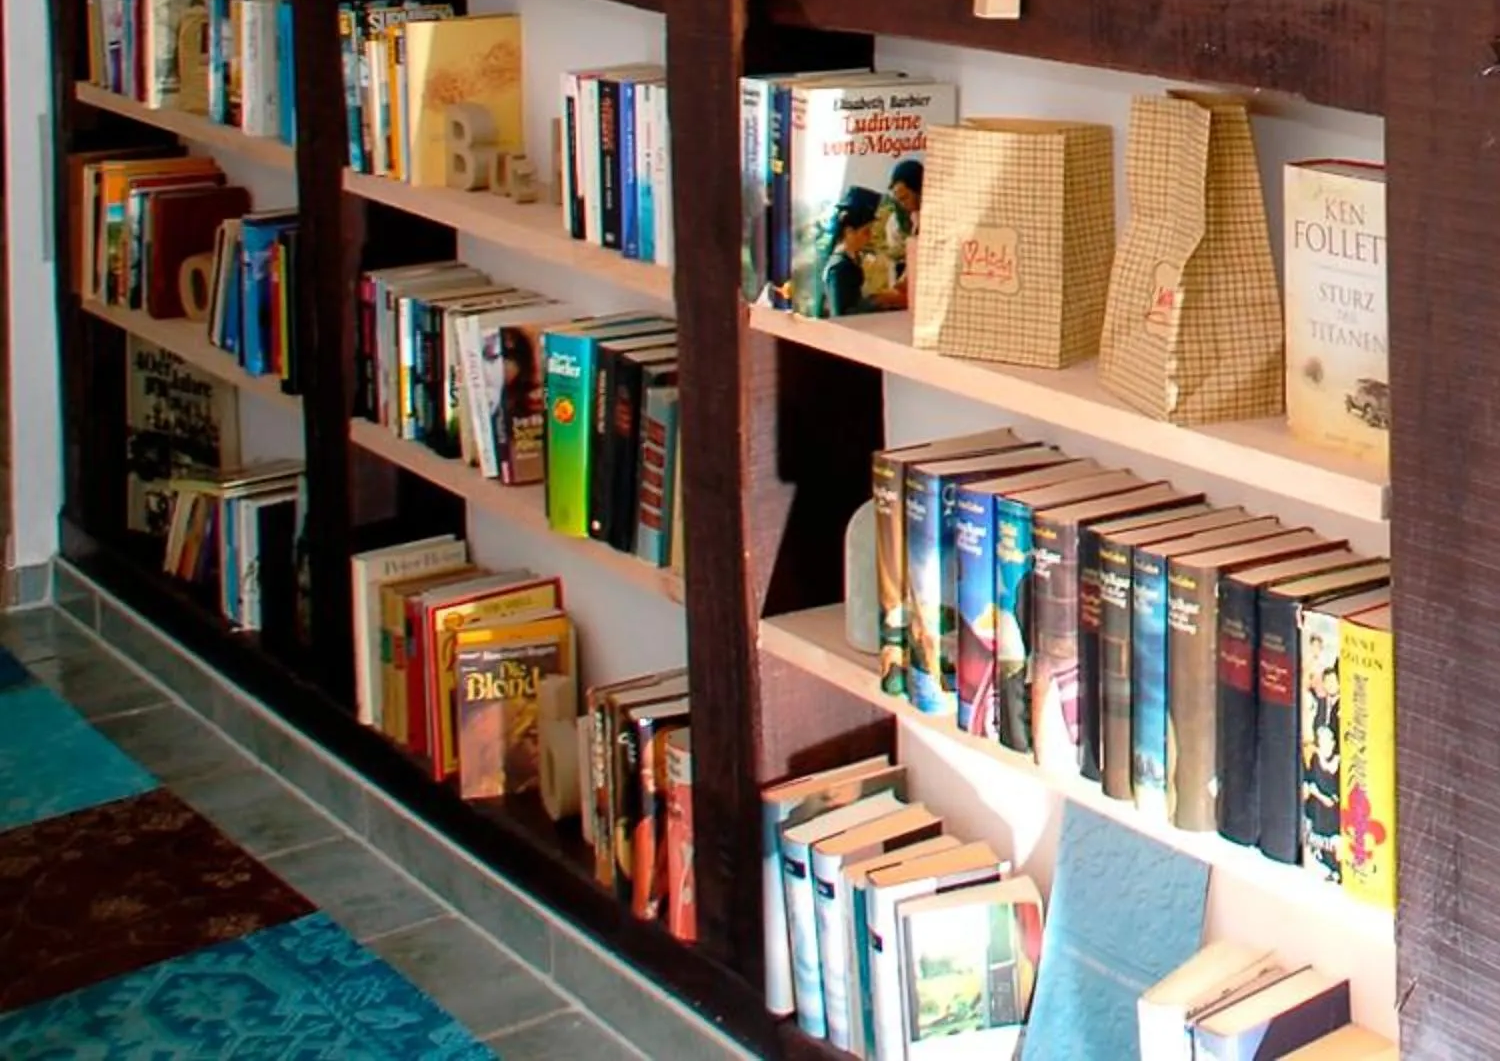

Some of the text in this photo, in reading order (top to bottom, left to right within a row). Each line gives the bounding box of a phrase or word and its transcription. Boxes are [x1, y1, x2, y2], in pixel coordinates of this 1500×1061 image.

[1325, 197, 1367, 225] KEN
[1294, 220, 1386, 265] FOLLET
[1318, 282, 1376, 313] STURZ
[467, 667, 541, 701] Blond
